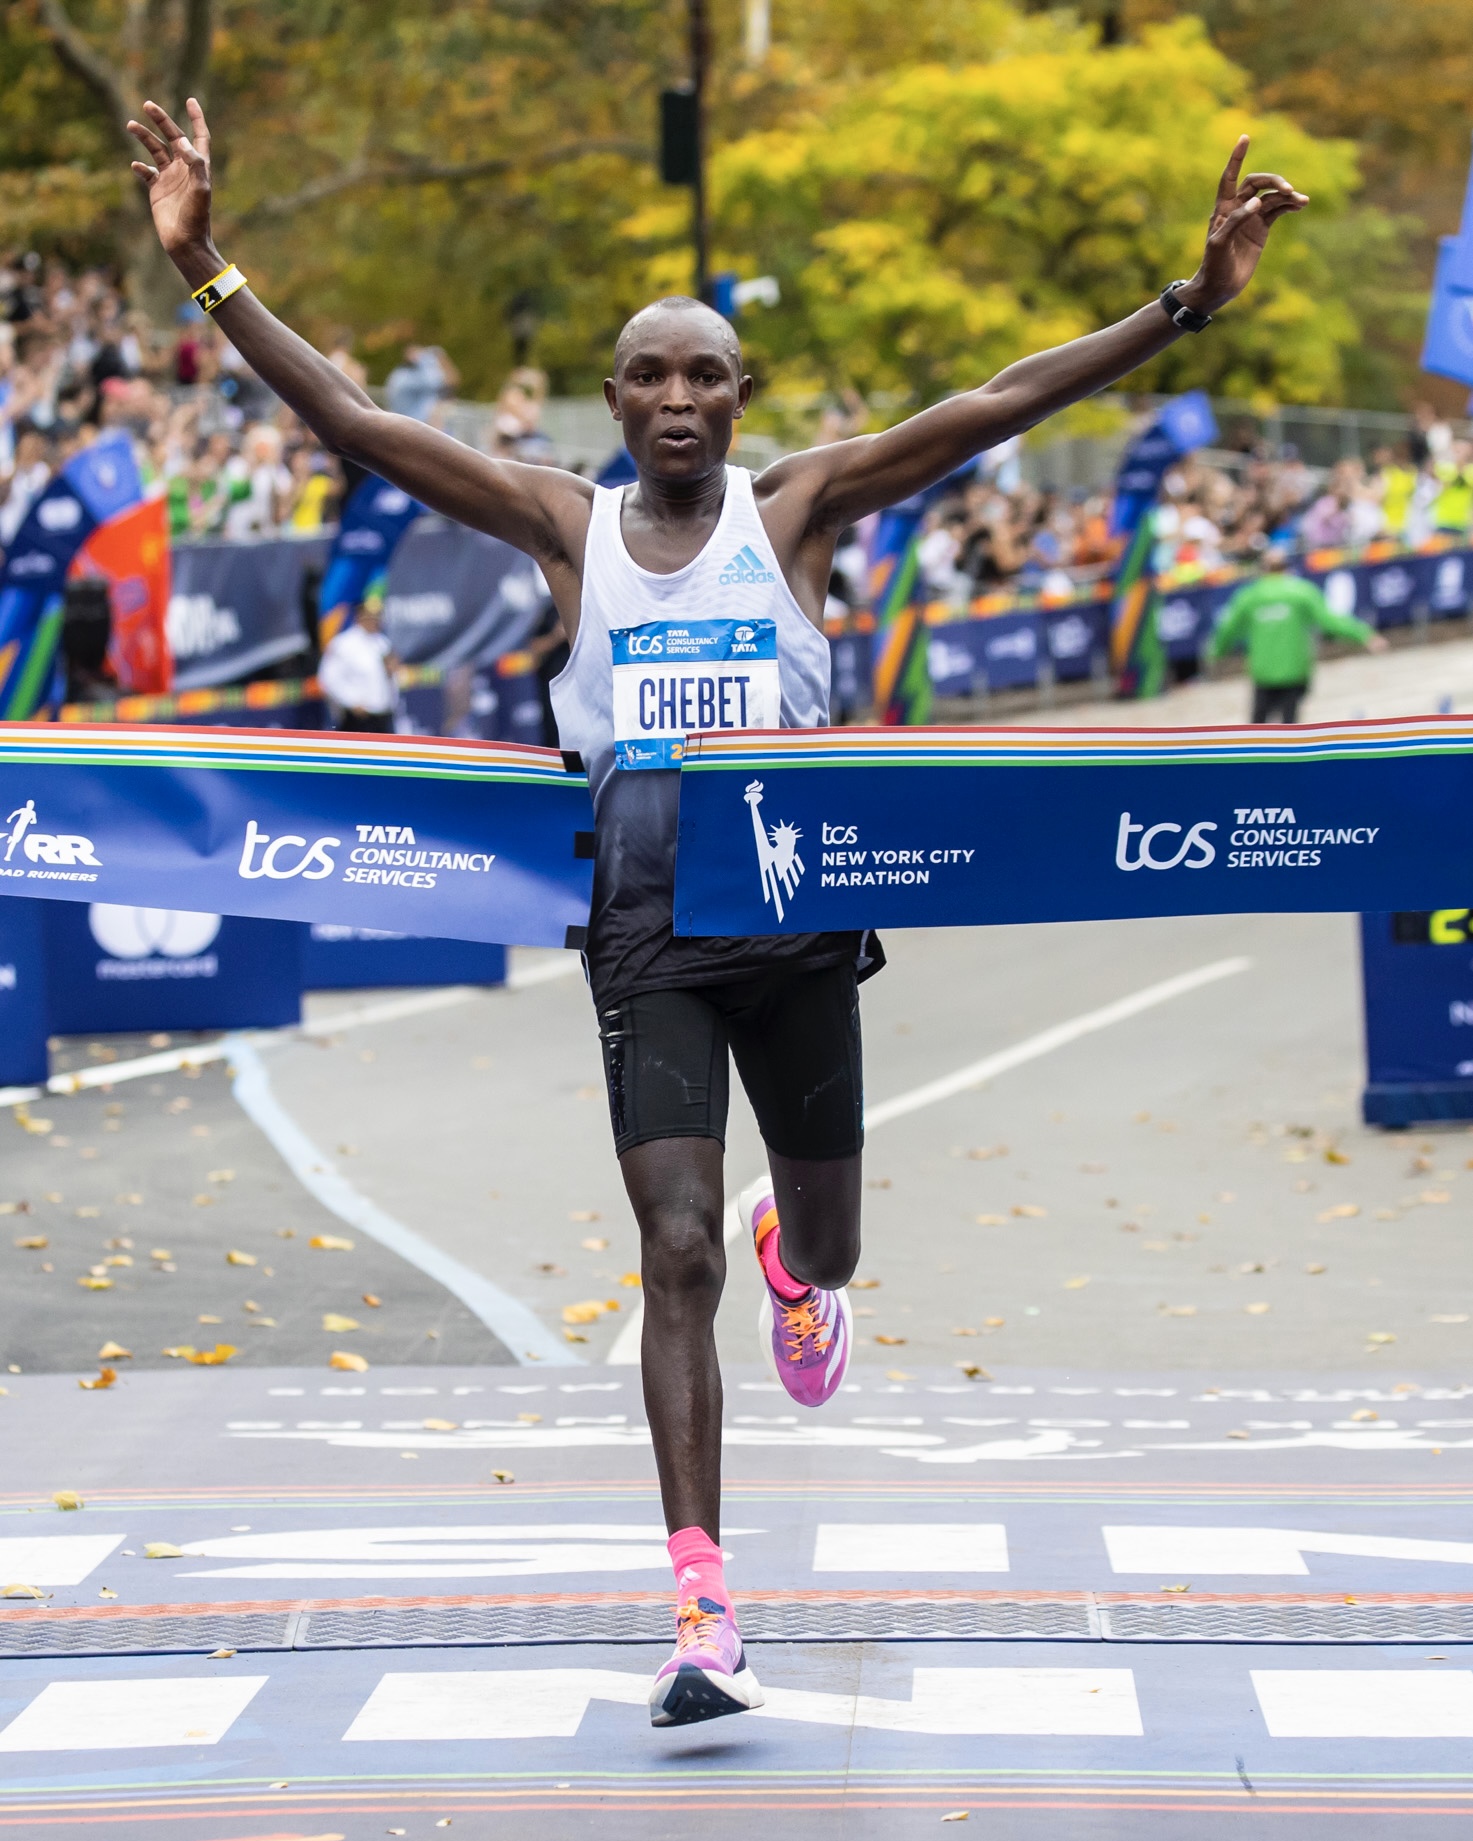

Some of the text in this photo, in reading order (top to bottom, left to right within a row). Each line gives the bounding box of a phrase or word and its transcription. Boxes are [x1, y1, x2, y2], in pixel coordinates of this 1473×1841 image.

[718, 569, 776, 586] adidas
[628, 632, 663, 655] tcs
[667, 637, 719, 646] CONSULTANCY
[667, 646, 700, 654] SERVICES
[731, 644, 758, 653] TATA
[639, 676, 750, 731] CHEBET
[1234, 807, 1296, 825] TATA
[356, 825, 416, 845] TATA
[822, 822, 858, 845] tcs
[1116, 811, 1218, 871] tcs
[1230, 827, 1380, 846] CONSULTANCY
[239, 820, 341, 880] tcs
[822, 849, 975, 866] NEW YORK CITY
[1227, 850, 1322, 868] SERVICES
[350, 847, 496, 872] CONSULTANCY
[27, 870, 99, 882] RUNNERS
[342, 867, 437, 889] SERVICES
[821, 870, 930, 887] MARATHON
